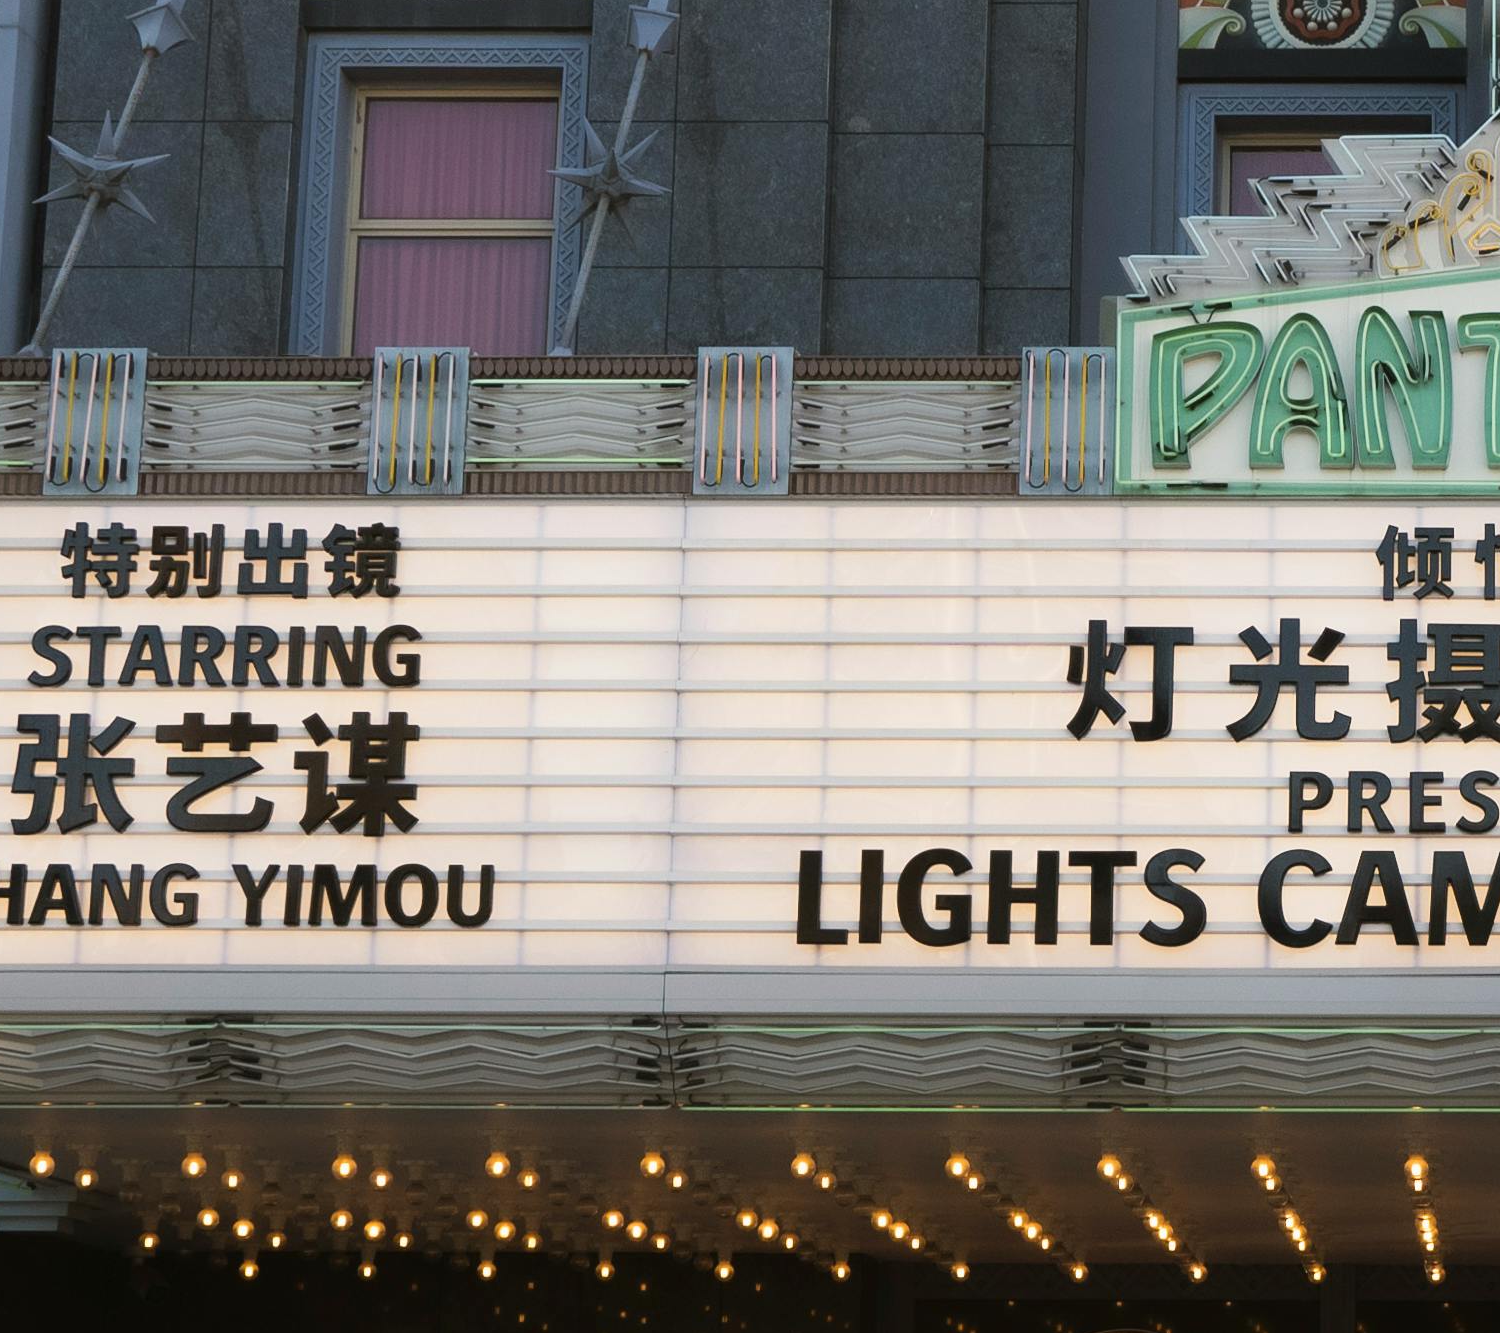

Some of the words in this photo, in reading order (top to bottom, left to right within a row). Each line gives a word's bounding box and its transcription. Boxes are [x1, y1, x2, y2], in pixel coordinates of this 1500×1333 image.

[61, 523, 400, 598] 特别出镜
[28, 625, 421, 687] STARRING
[11, 712, 419, 836] 张艺谋
[233, 864, 494, 927] YIMOU
[797, 849, 1206, 947] LIGHTS
